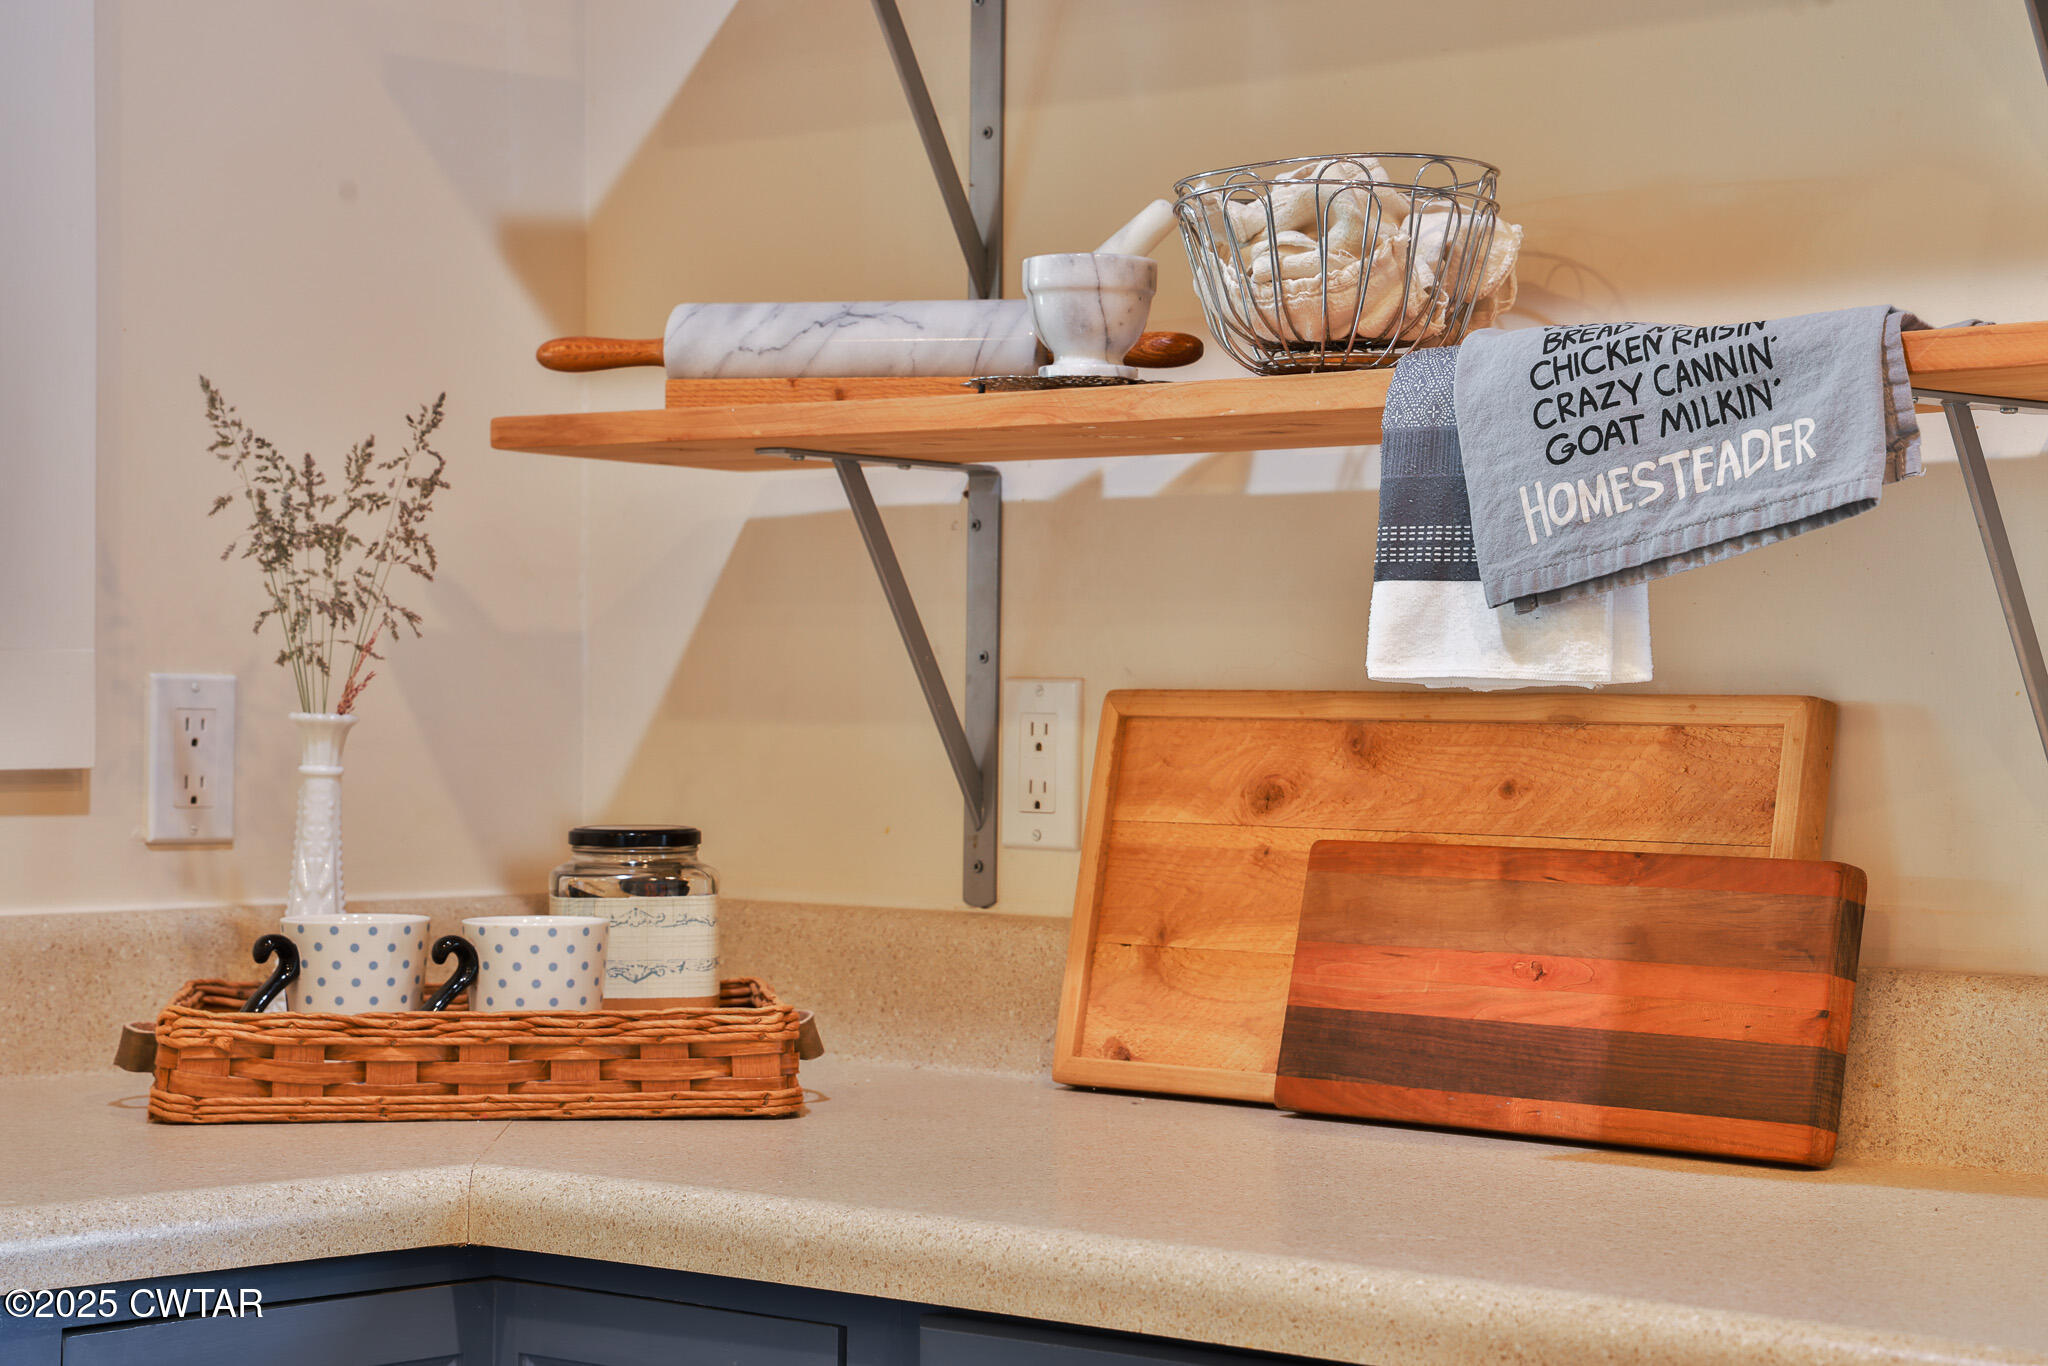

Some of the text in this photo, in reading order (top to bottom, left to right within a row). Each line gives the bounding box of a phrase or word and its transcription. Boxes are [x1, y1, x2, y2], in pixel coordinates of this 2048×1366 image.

[1529, 334, 1664, 391] CHICKEN
[1533, 335, 1778, 430] CRAZY CANNIN'
[1542, 324, 1635, 355] BREAD
[1545, 377, 1781, 466] GOAT MILKIN'
[1519, 417, 1817, 546] HOMESTEADER
